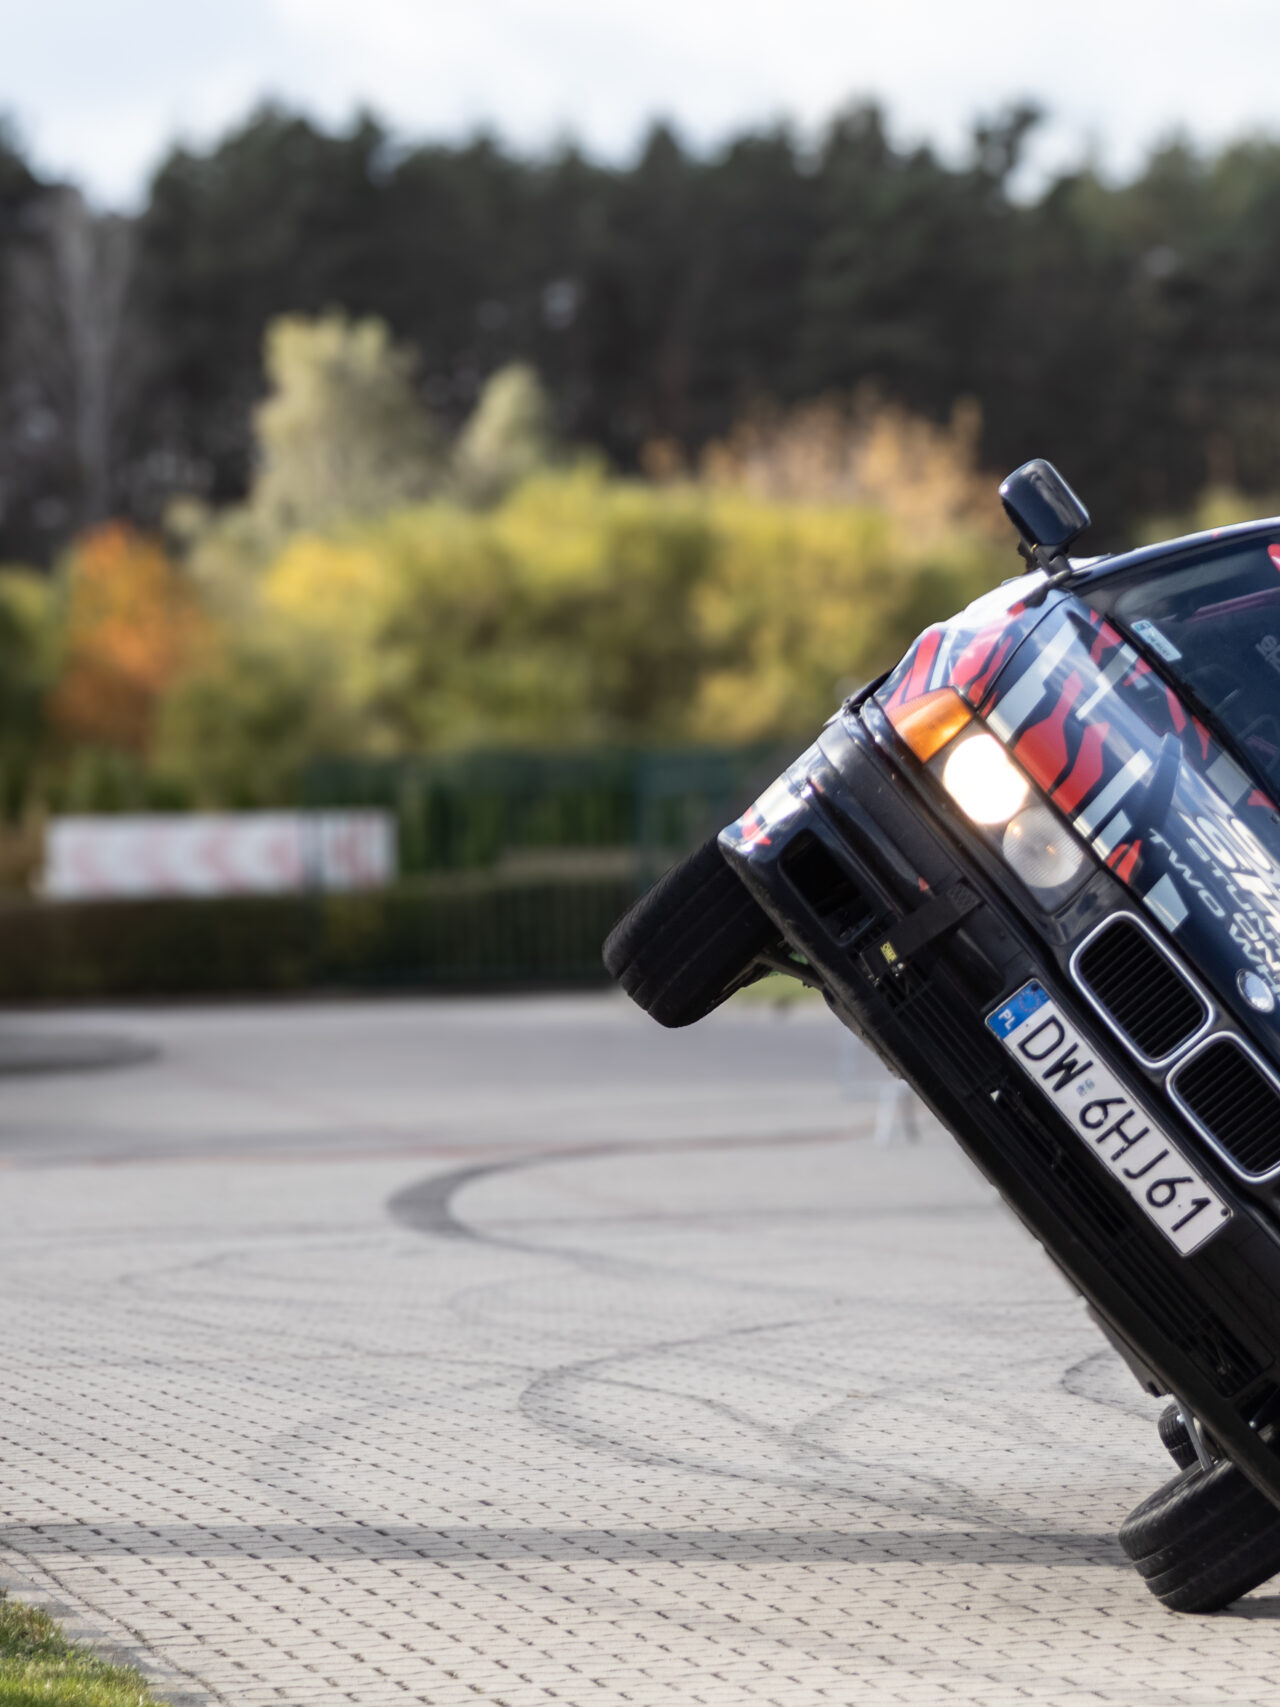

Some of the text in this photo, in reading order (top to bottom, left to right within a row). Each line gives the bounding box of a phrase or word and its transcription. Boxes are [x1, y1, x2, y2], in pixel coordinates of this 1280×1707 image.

[1148, 827, 1226, 918] TWO
[997, 1008, 1018, 1031] PL
[1016, 1013, 1213, 1234] DW 6HJ61
